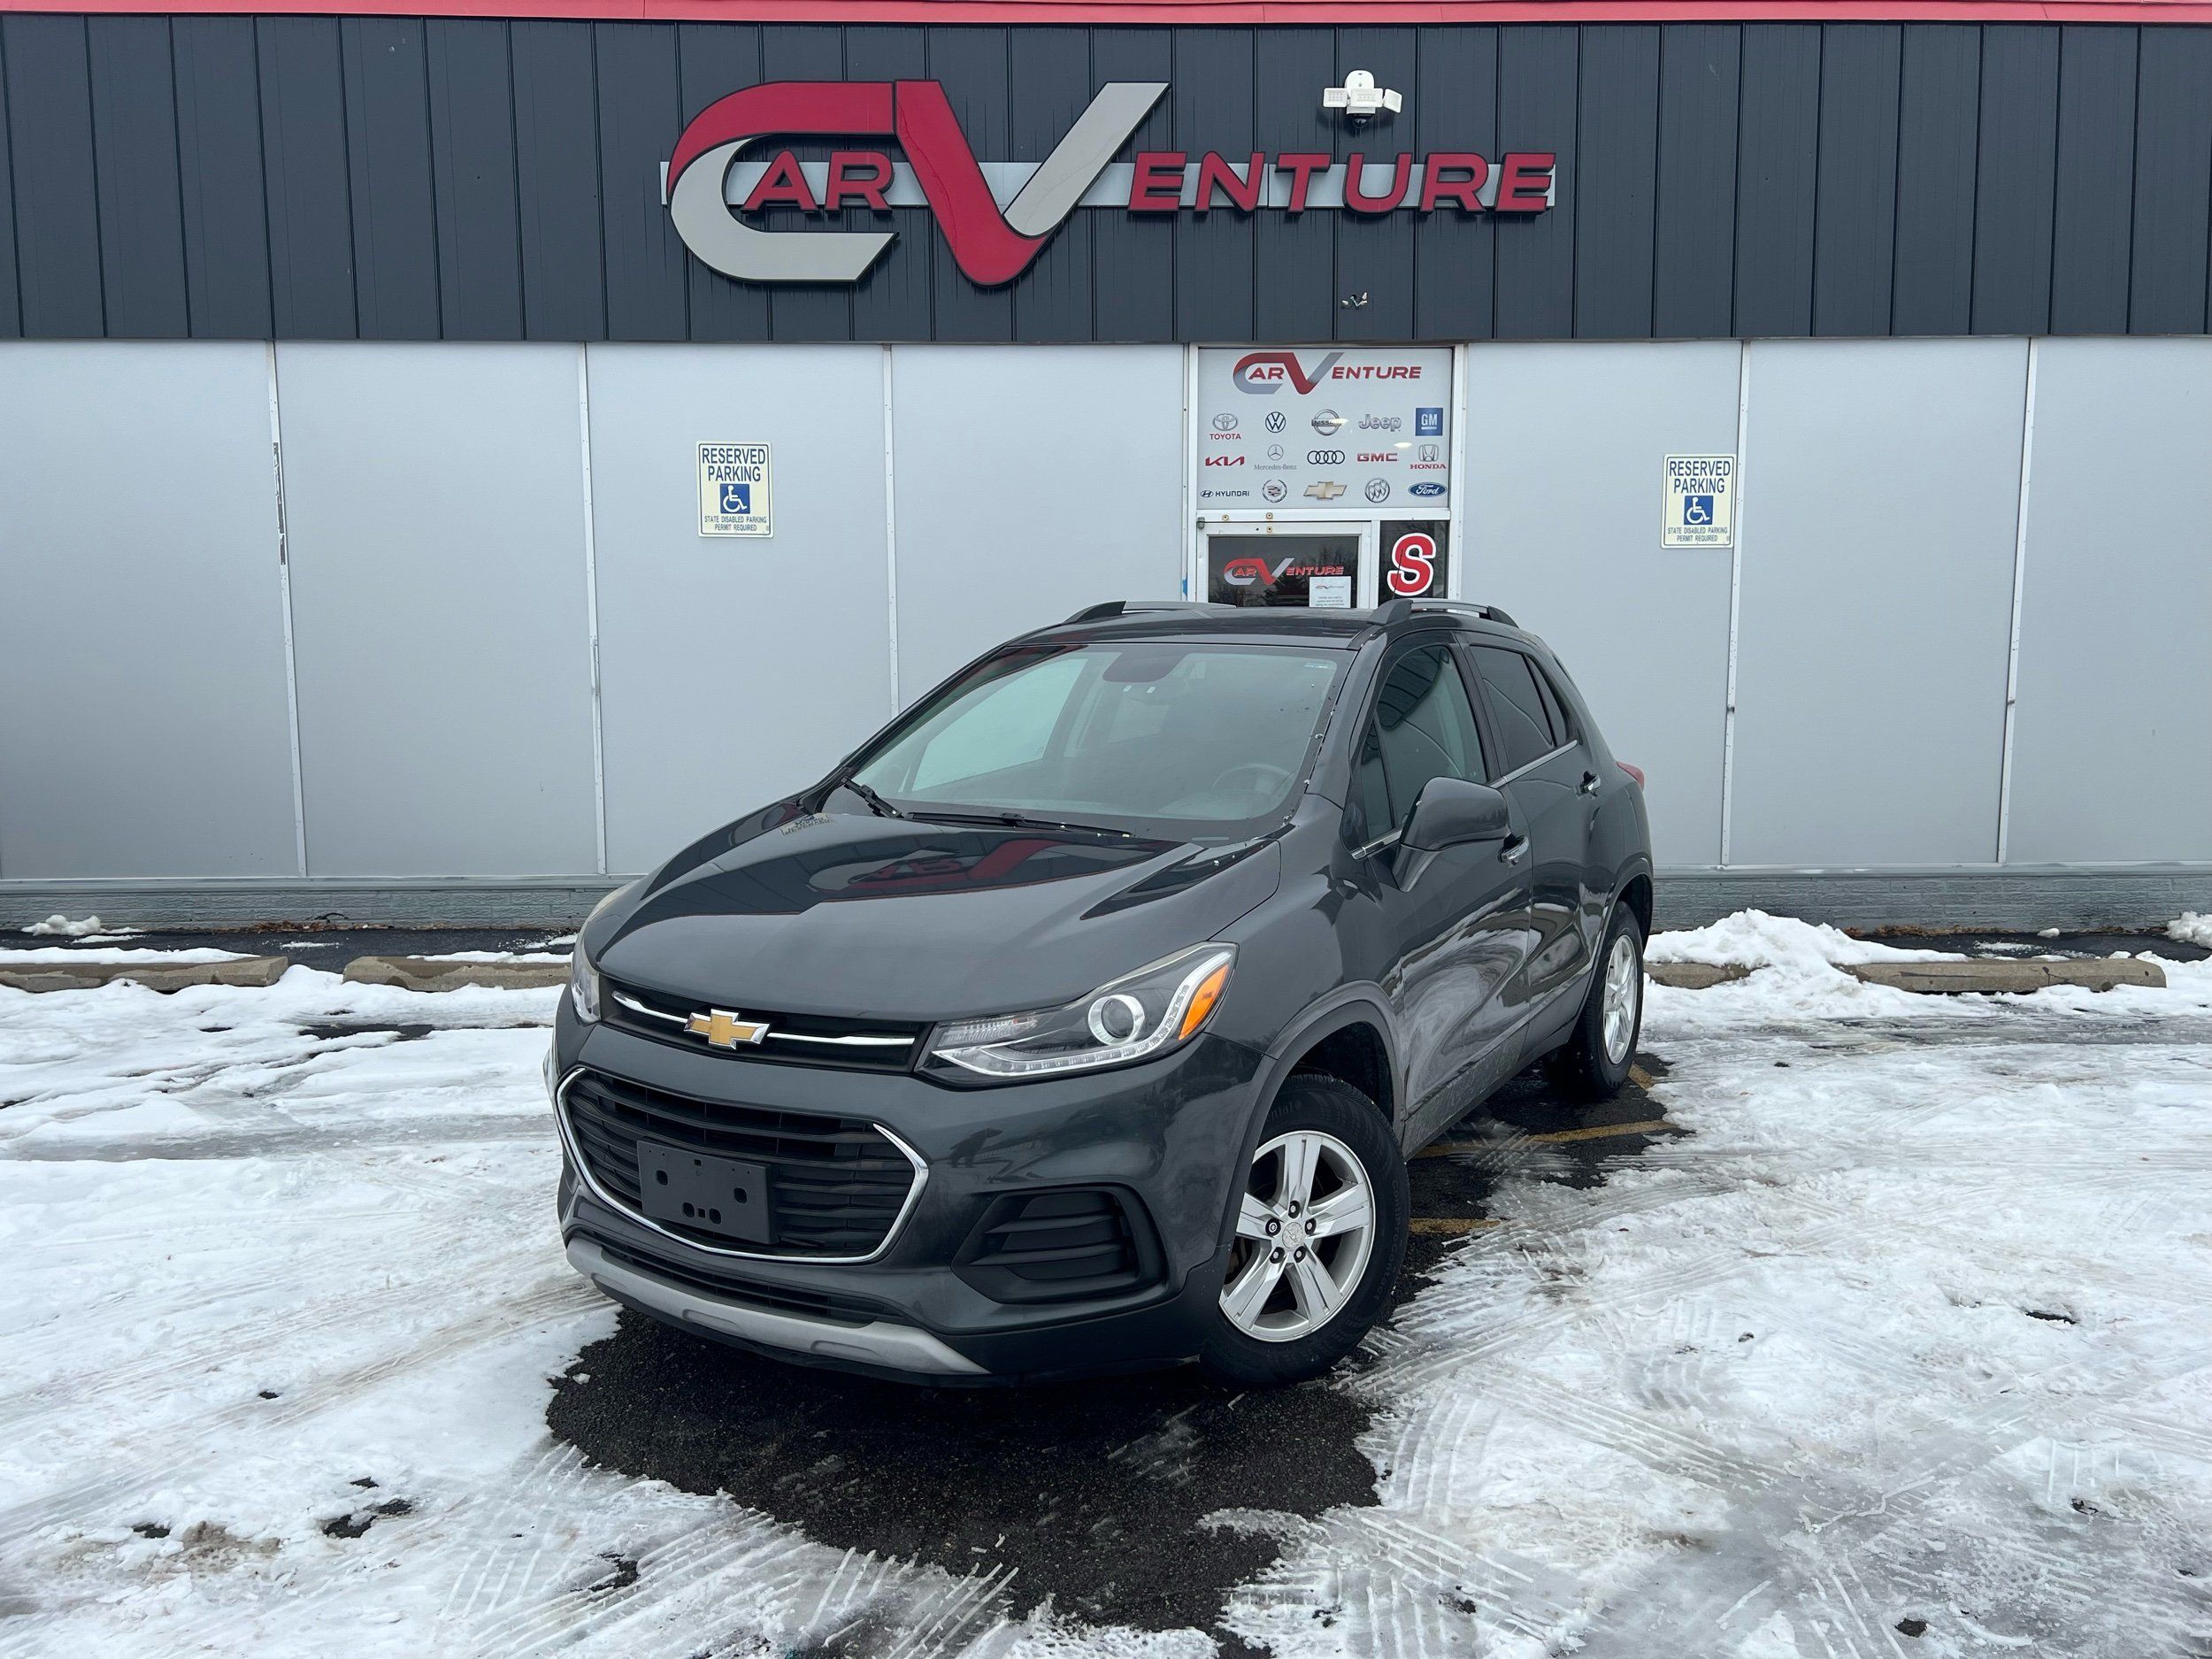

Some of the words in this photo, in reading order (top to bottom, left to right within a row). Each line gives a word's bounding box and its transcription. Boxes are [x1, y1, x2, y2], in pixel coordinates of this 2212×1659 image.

[1358, 413, 1402, 432] Jeep
[1421, 413, 1438, 426] GM
[702, 448, 766, 465] RESERVED
[1205, 456, 1245, 466] KIA
[1356, 453, 1398, 462] GMC
[708, 465, 762, 482] PARKING
[1669, 460, 1731, 477] RESERVED
[1416, 484, 1440, 495] Ford
[1673, 478, 1725, 494] PARKING
[1386, 532, 1437, 597] S
